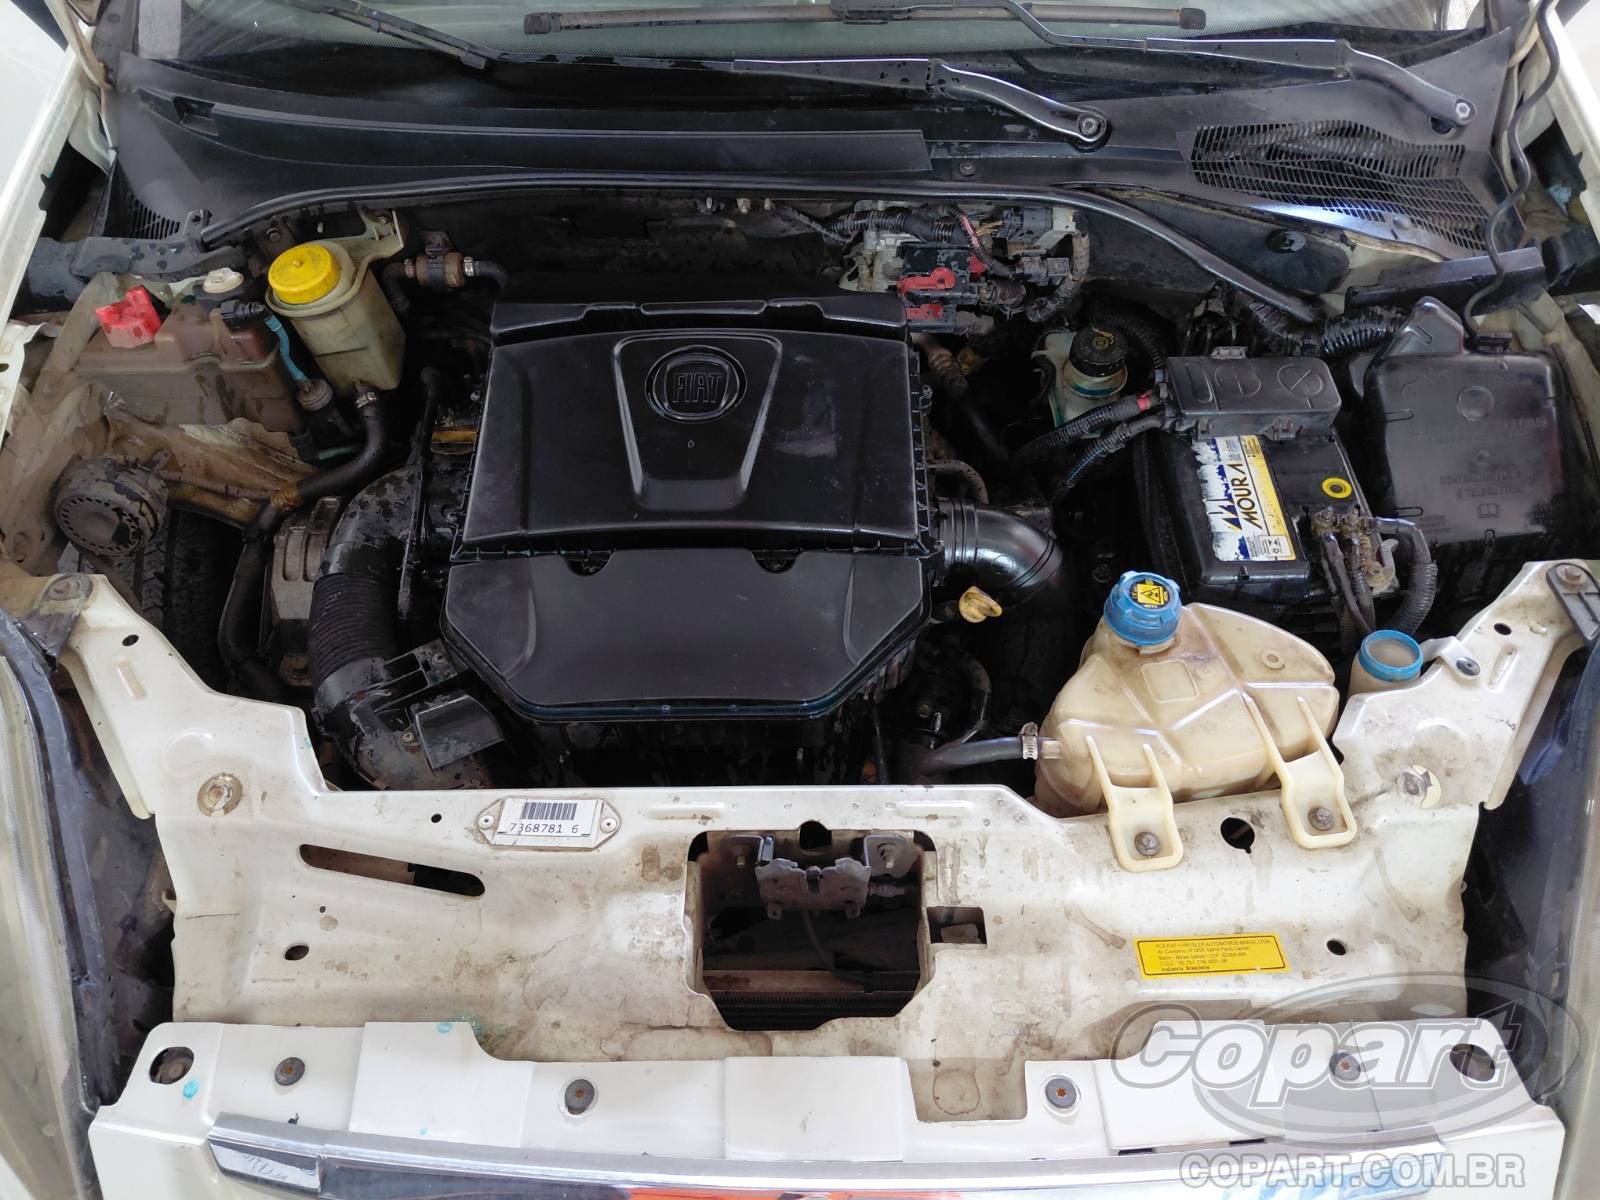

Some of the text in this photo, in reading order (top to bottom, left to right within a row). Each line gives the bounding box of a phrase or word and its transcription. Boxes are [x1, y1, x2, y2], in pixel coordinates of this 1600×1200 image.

[672, 372, 722, 403] FIAT
[1226, 463, 1263, 530] MOURA
[510, 822, 579, 834] 7368781 6
